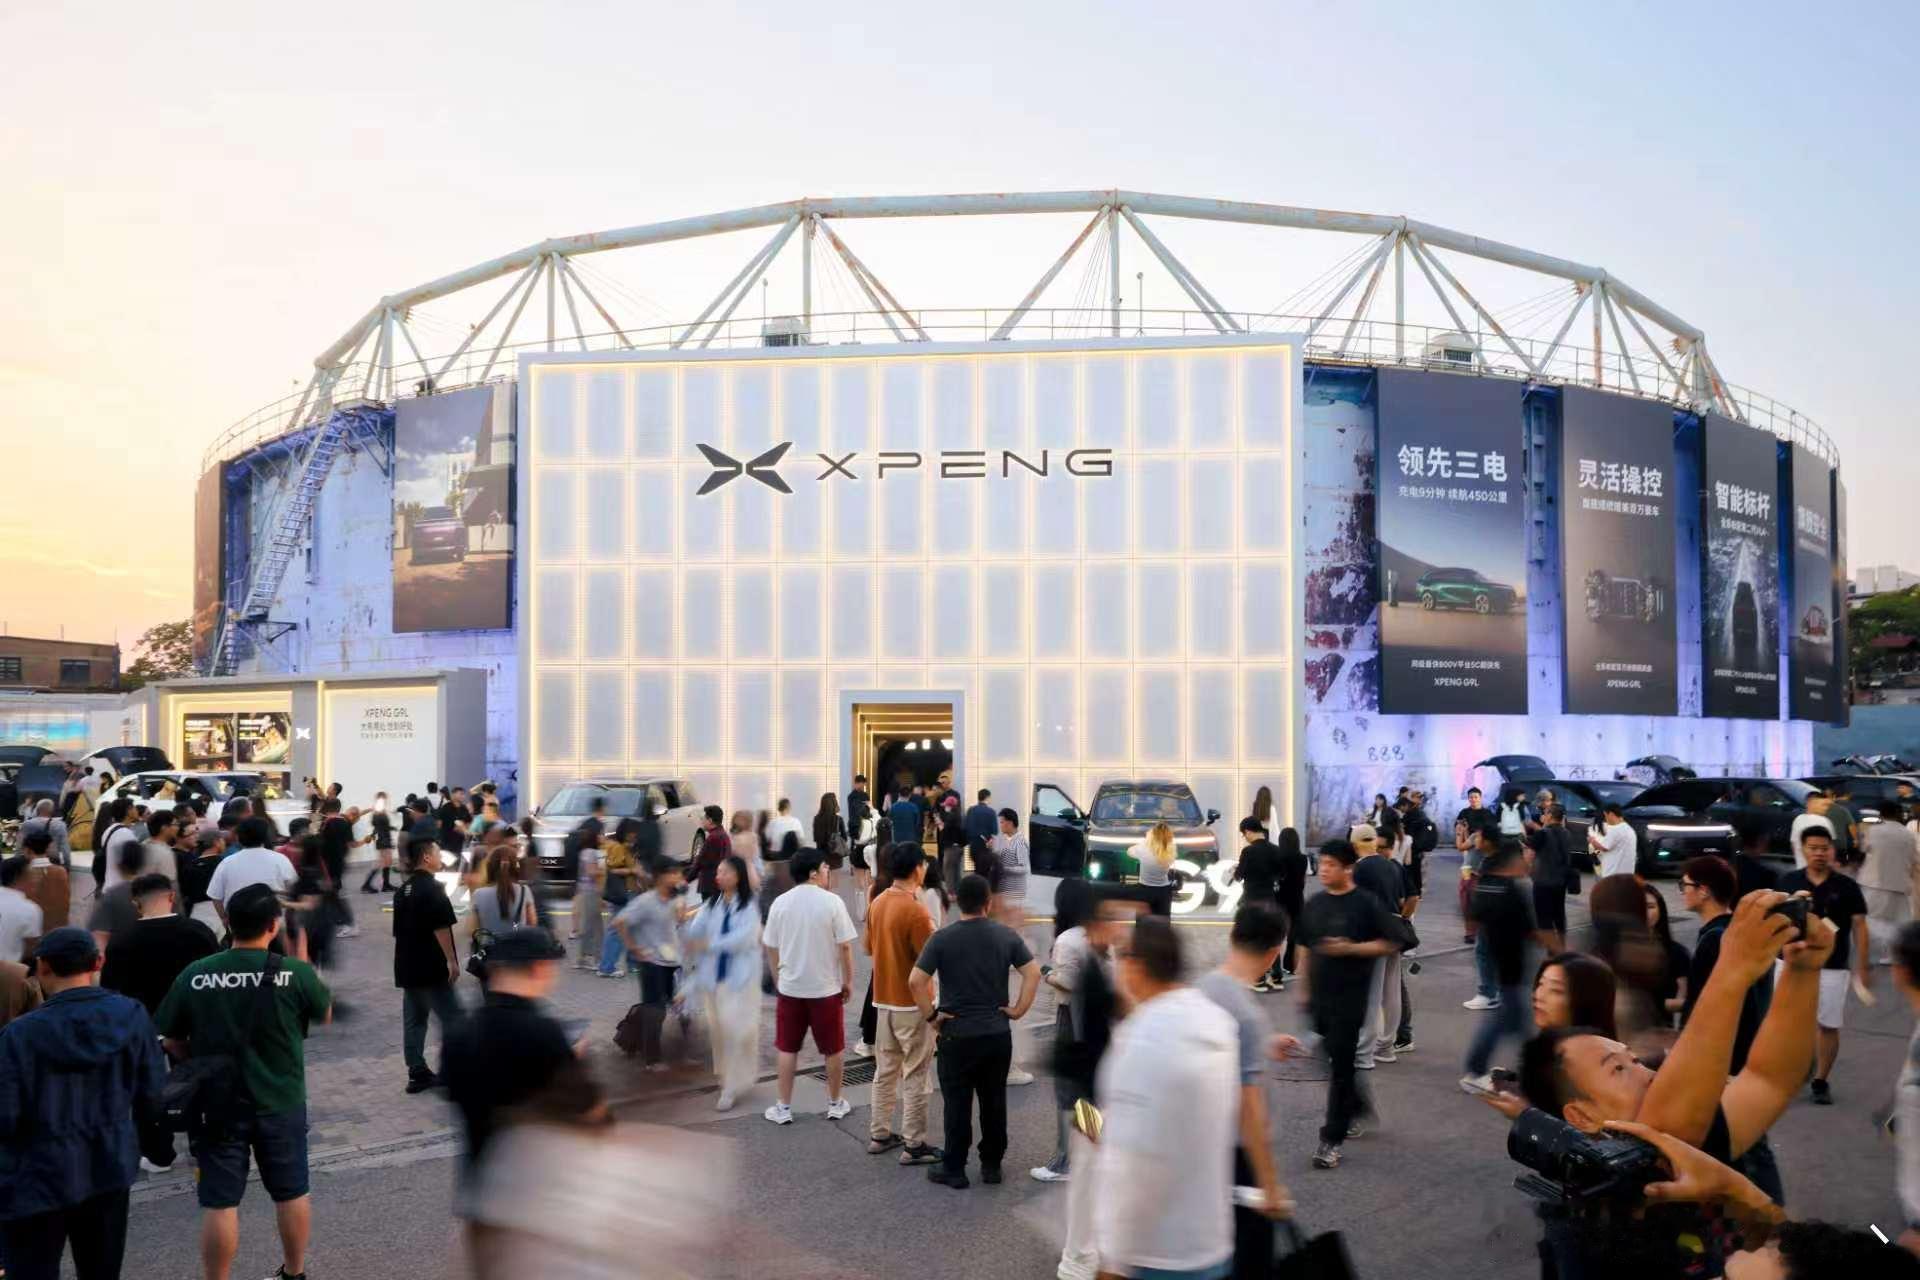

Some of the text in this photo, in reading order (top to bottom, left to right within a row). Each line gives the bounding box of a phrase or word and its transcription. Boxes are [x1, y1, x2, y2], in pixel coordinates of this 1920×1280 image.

[816, 448, 1112, 480] XPENG
[1397, 443, 1508, 482] 领先三电
[1578, 458, 1663, 497] 灵活操控
[1447, 488, 1508, 504] 续航450公里
[1714, 479, 1771, 520] 智能标杆
[1433, 677, 1463, 687] XPENG
